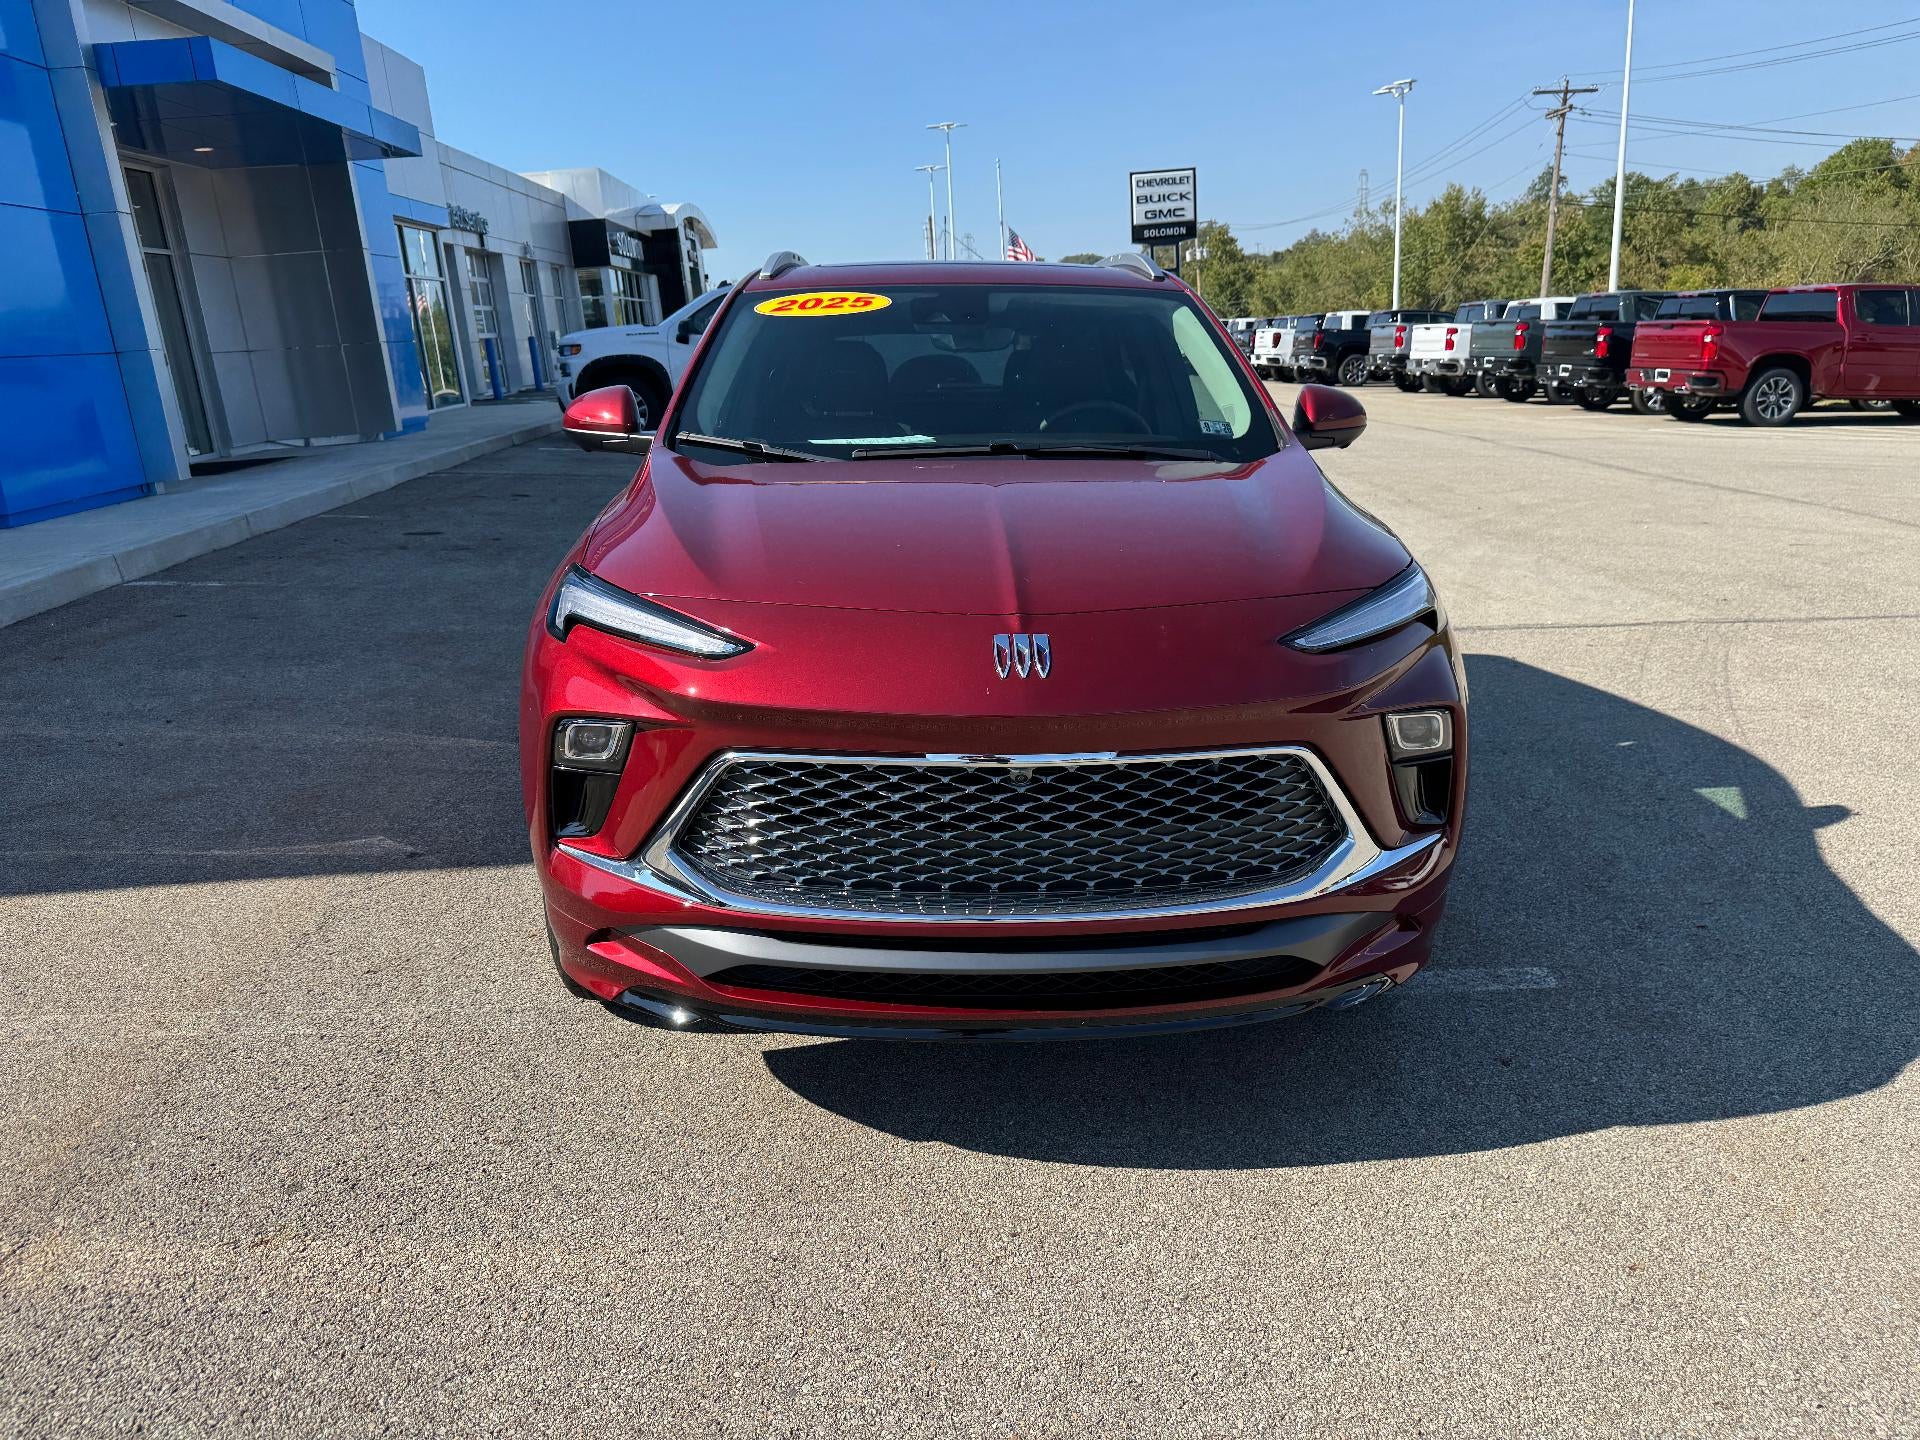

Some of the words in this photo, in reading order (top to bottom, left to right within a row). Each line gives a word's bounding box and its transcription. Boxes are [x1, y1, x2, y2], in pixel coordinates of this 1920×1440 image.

[1136, 176, 1191, 188] CHEVROLET
[1136, 192, 1191, 204] BUICK
[1144, 208, 1185, 220] GMC
[1143, 226, 1187, 238] SOLOMON
[769, 296, 876, 312] 2025
